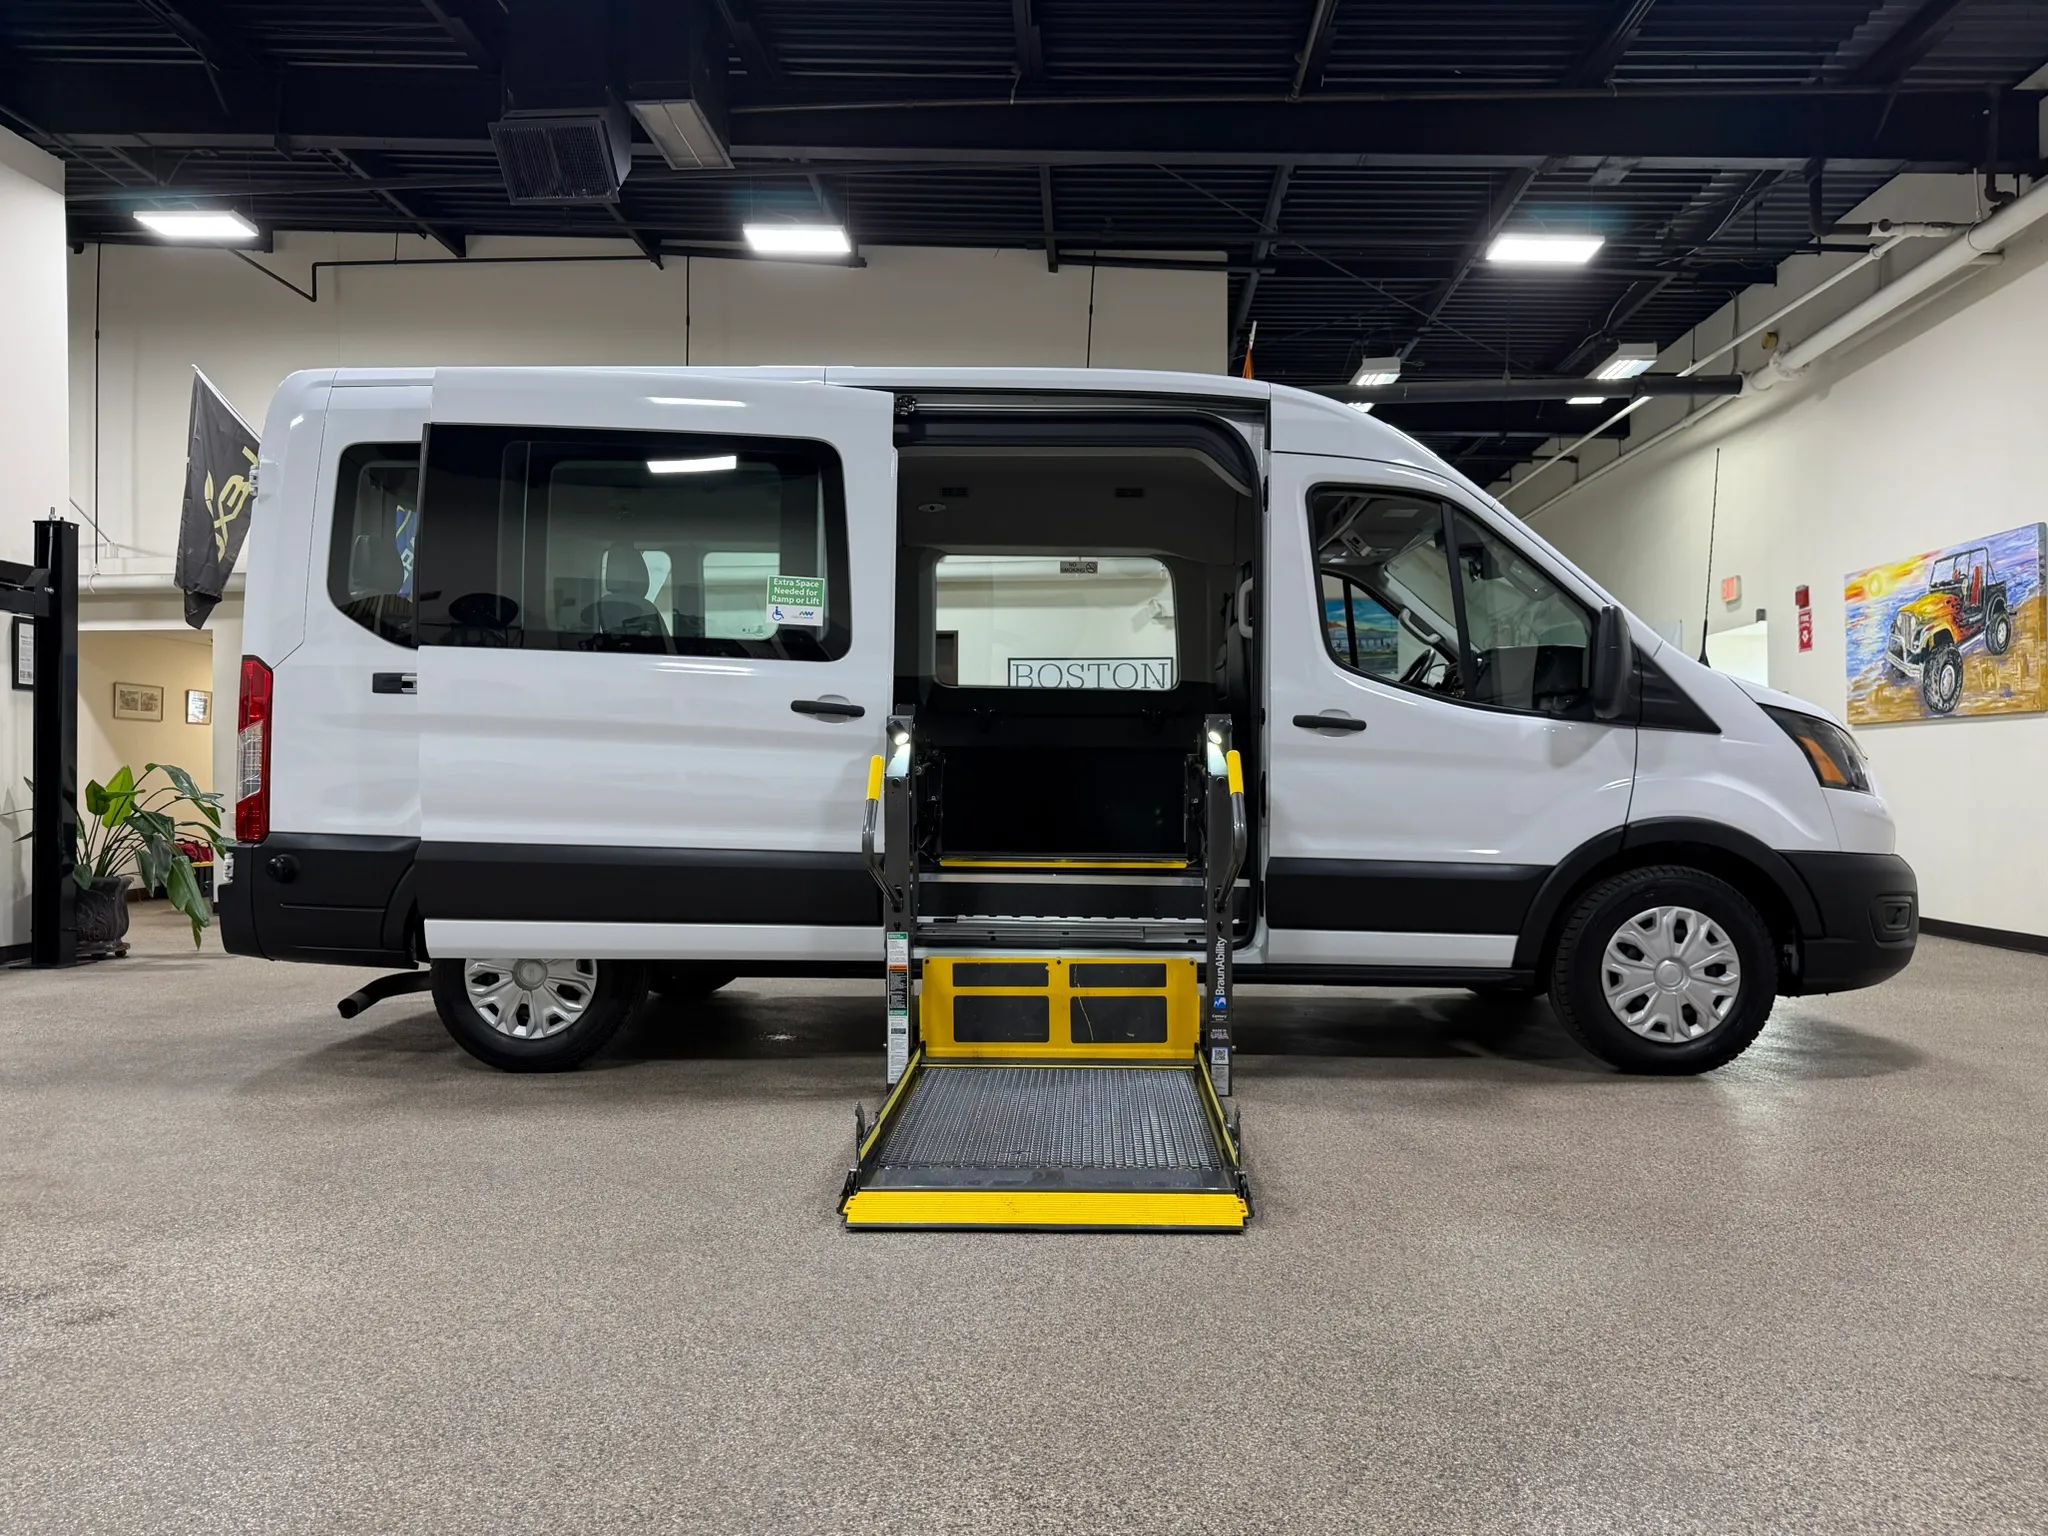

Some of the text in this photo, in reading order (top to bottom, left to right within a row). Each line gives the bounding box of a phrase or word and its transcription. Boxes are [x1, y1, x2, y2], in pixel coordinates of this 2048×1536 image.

[773, 578, 820, 588] Extra Space
[774, 587, 805, 595] Needed
[771, 595, 795, 604] Ramp
[806, 597, 821, 605] Lift
[1012, 663, 1169, 689] BOSTON
[1215, 935, 1228, 996] BraunAbility
